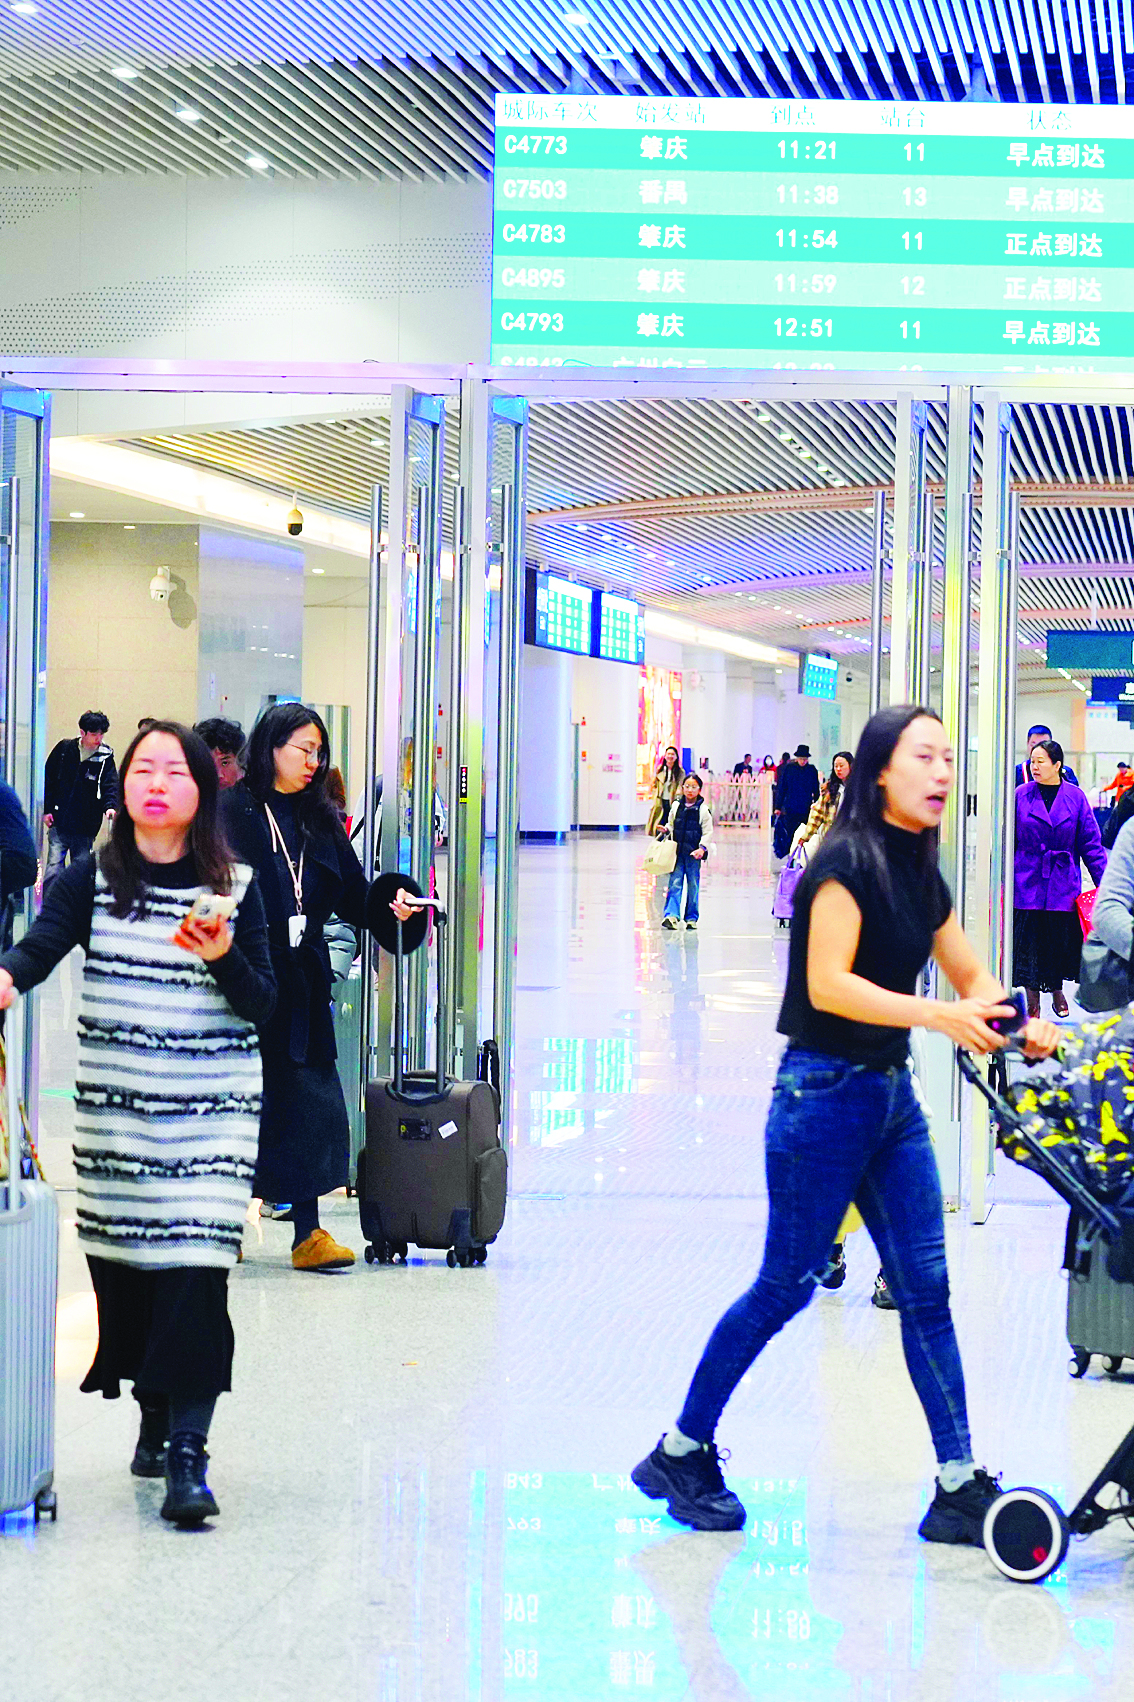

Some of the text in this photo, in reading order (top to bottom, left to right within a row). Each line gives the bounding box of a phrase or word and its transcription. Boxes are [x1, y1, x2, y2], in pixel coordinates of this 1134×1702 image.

[504, 100, 1070, 130] 城际车次 始发站 到点 站台 状态
[505, 135, 1104, 167] C4773 肇庆 11:21 11 早点到达
[504, 180, 566, 198] C7503
[777, 185, 838, 204] 11:38
[903, 187, 926, 206] 13
[1006, 187, 1104, 212] 早点到达
[503, 224, 1102, 256] C4783 肇庆 11:54 11 正点到达
[502, 268, 564, 287] C4895
[775, 274, 836, 293] 11:59
[901, 276, 924, 295] 12
[1004, 277, 1101, 301] 正点到达
[502, 313, 1100, 345] C4793 肇庆 12:51 11 早点到达
